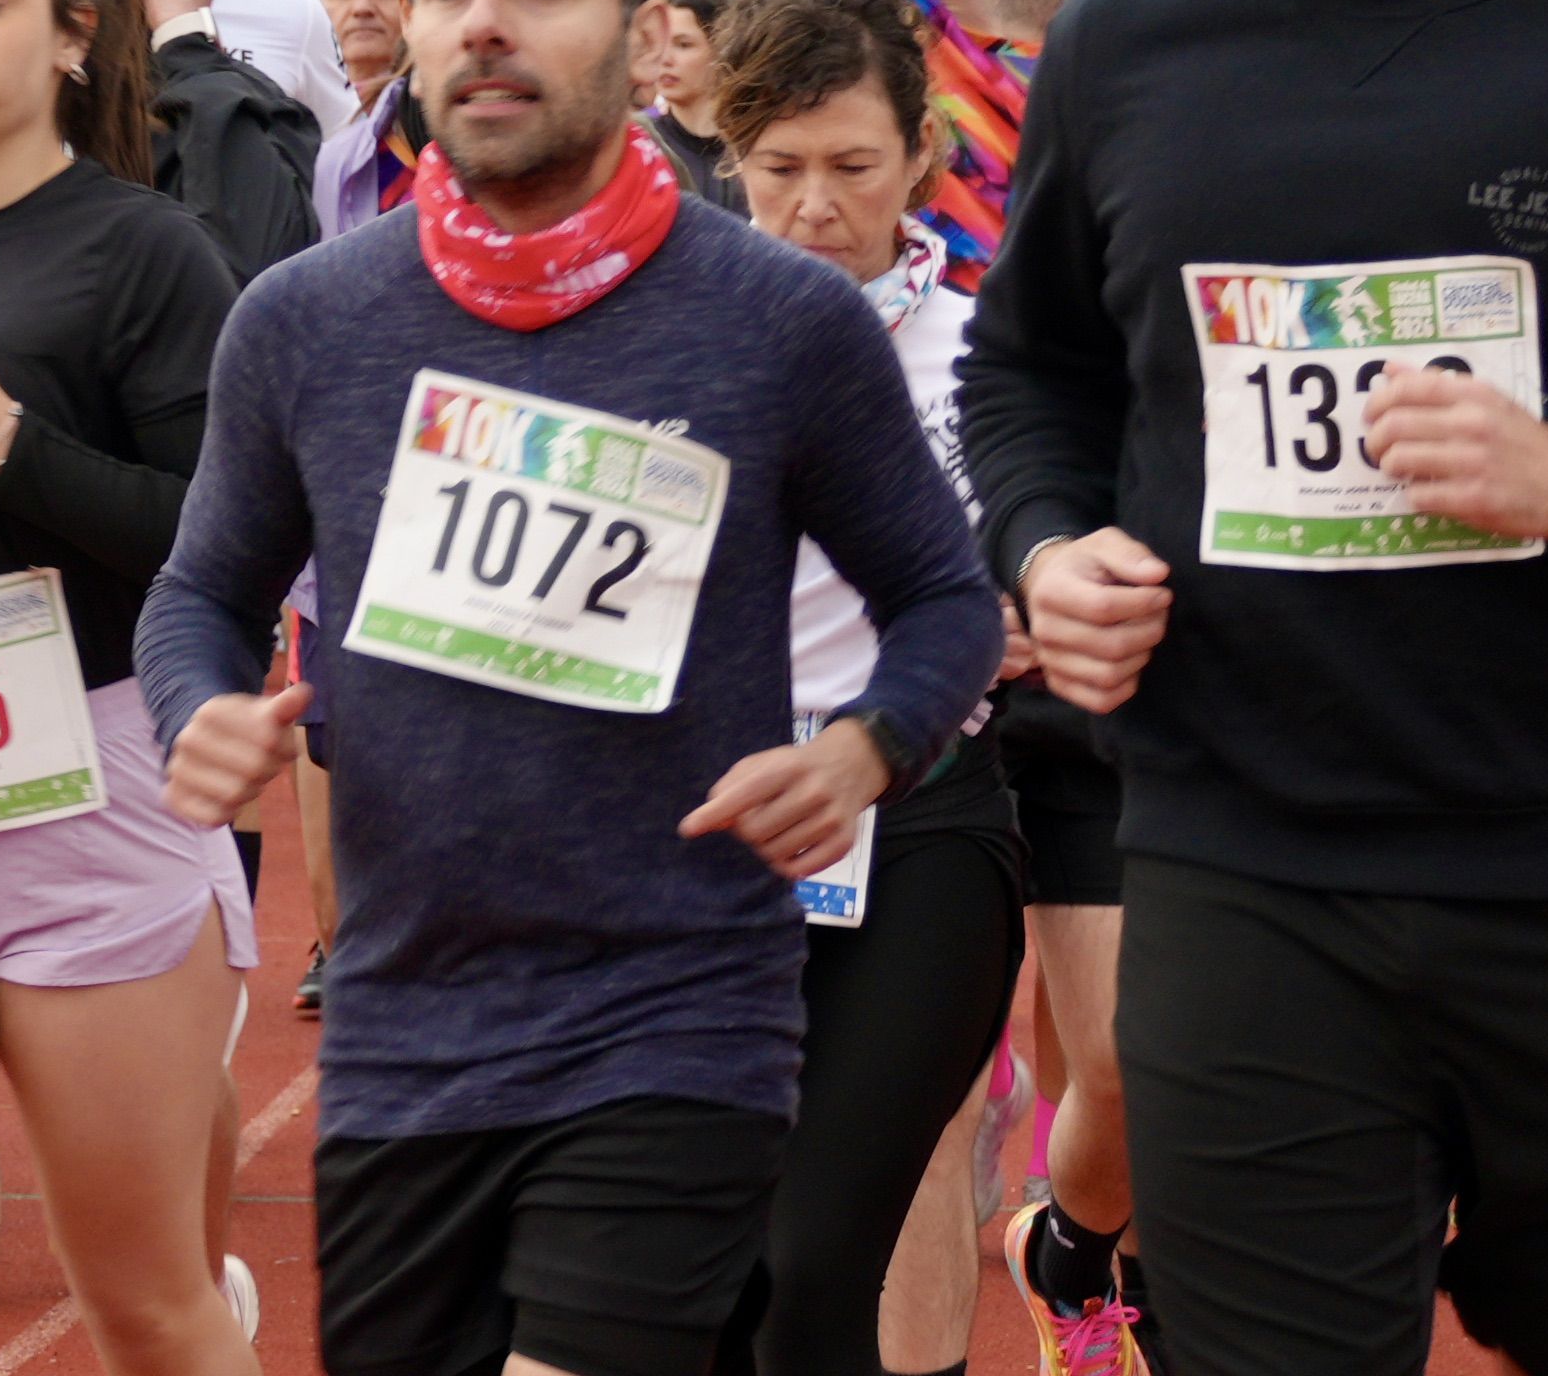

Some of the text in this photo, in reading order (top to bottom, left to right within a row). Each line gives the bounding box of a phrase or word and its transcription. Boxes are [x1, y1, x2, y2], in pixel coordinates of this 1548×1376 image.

[1467, 181, 1516, 210] LEE
[1219, 277, 1311, 349] 10K
[437, 395, 538, 476] 10K
[1246, 354, 1473, 473] 13
[427, 477, 653, 622] 1072
